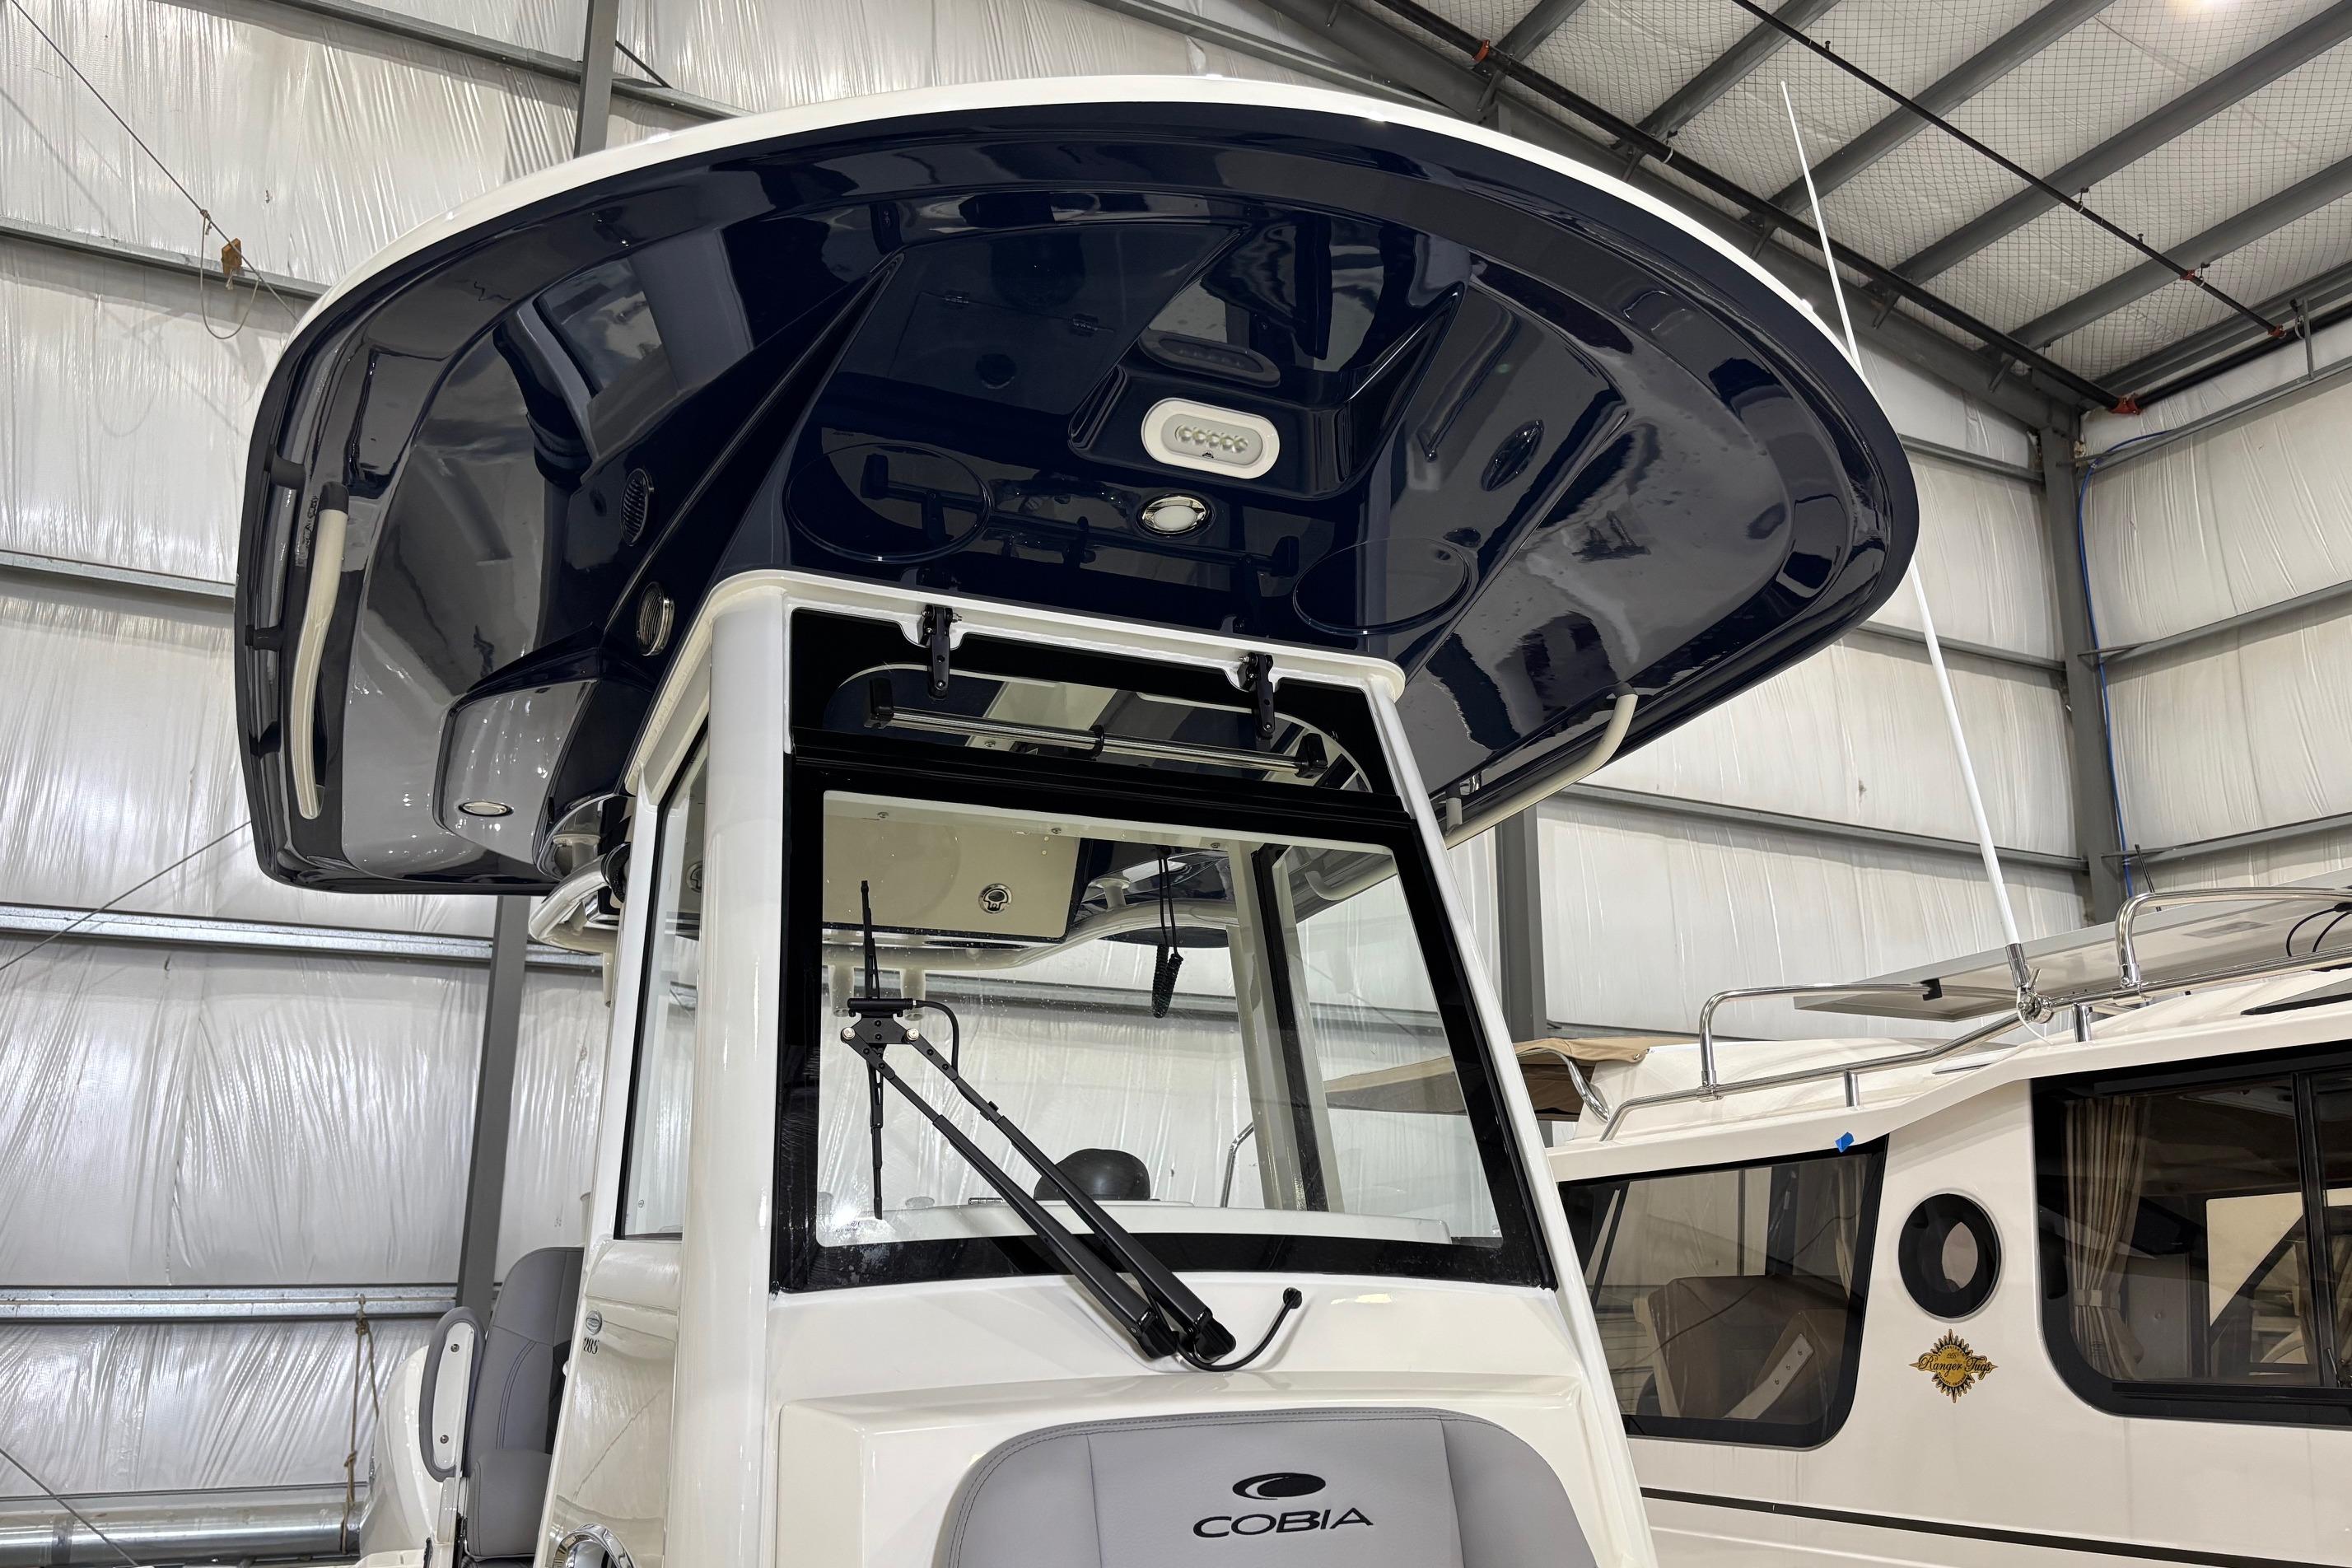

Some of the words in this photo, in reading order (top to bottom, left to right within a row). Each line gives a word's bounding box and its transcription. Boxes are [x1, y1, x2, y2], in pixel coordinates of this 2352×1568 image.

[1918, 1354, 1962, 1377] Ranger
[1964, 1356, 1990, 1379] Tugs
[1192, 1507, 1374, 1538] COBIA
